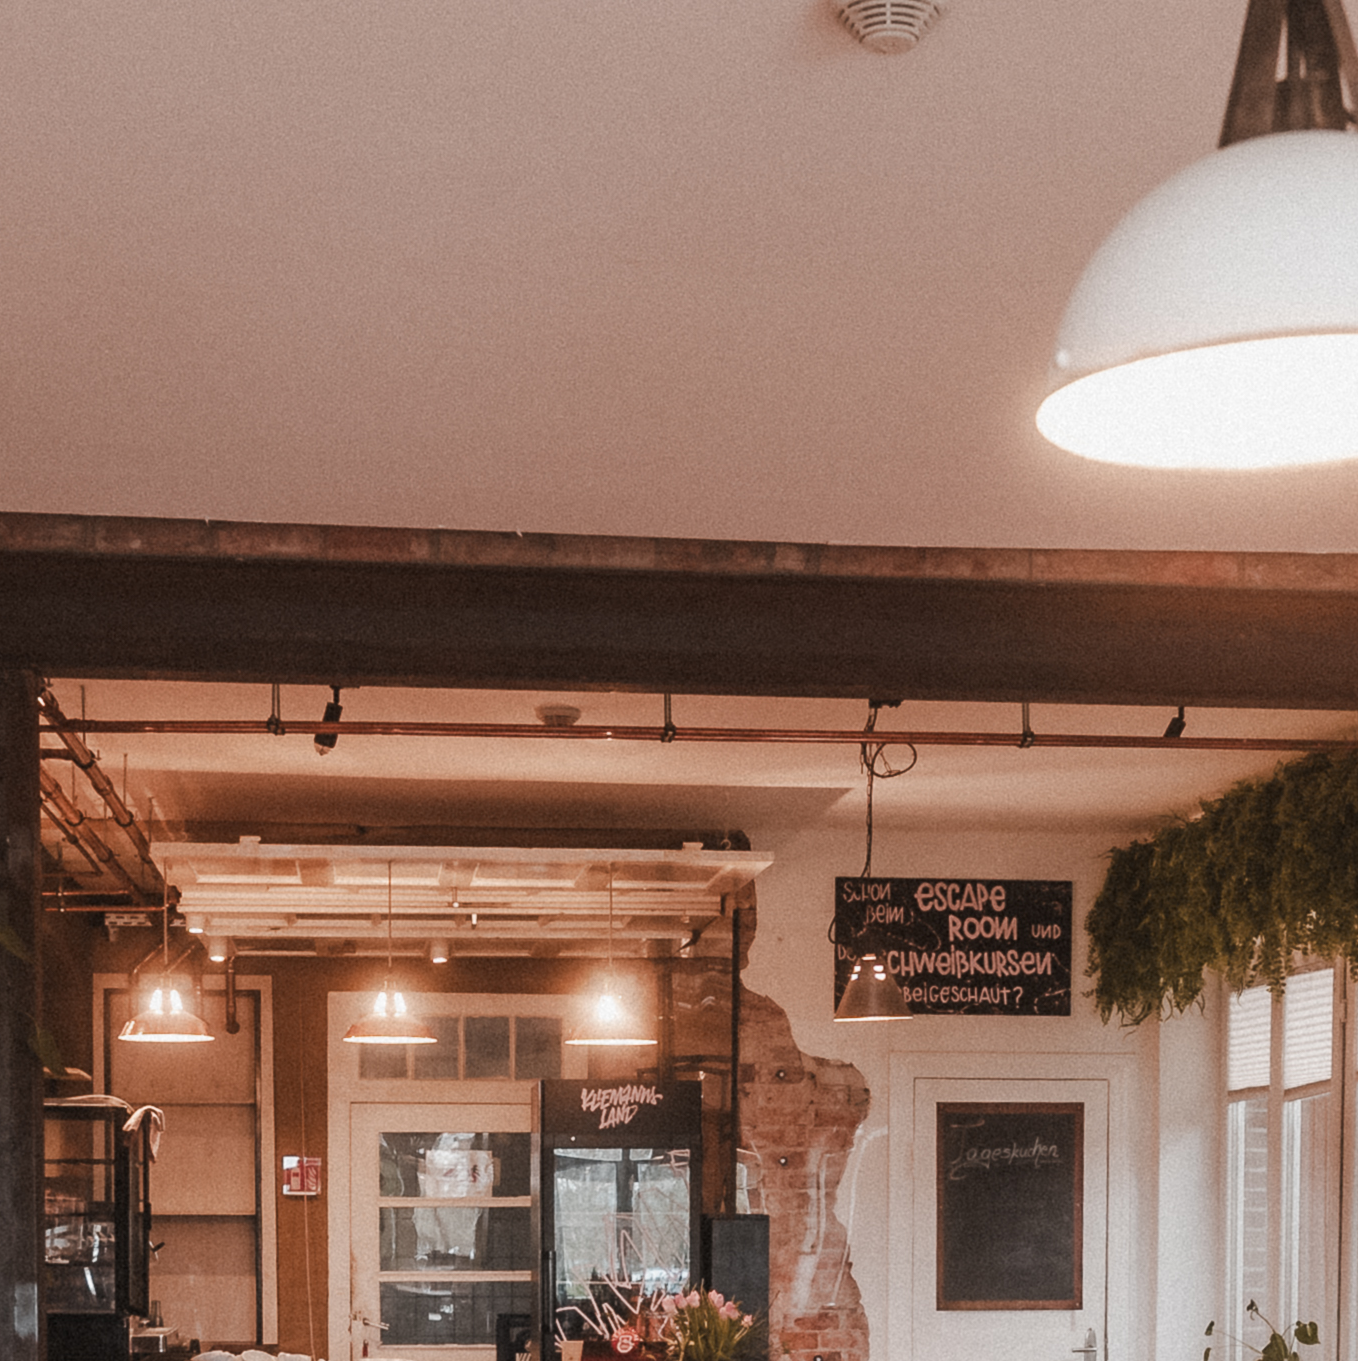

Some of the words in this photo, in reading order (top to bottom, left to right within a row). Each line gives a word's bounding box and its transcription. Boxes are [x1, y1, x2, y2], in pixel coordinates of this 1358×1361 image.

[948, 914, 1018, 942] ROOM
[1031, 923, 1062, 939] UND
[599, 1104, 639, 1130] LAND
[949, 1119, 1060, 1172] Tageskuchen
